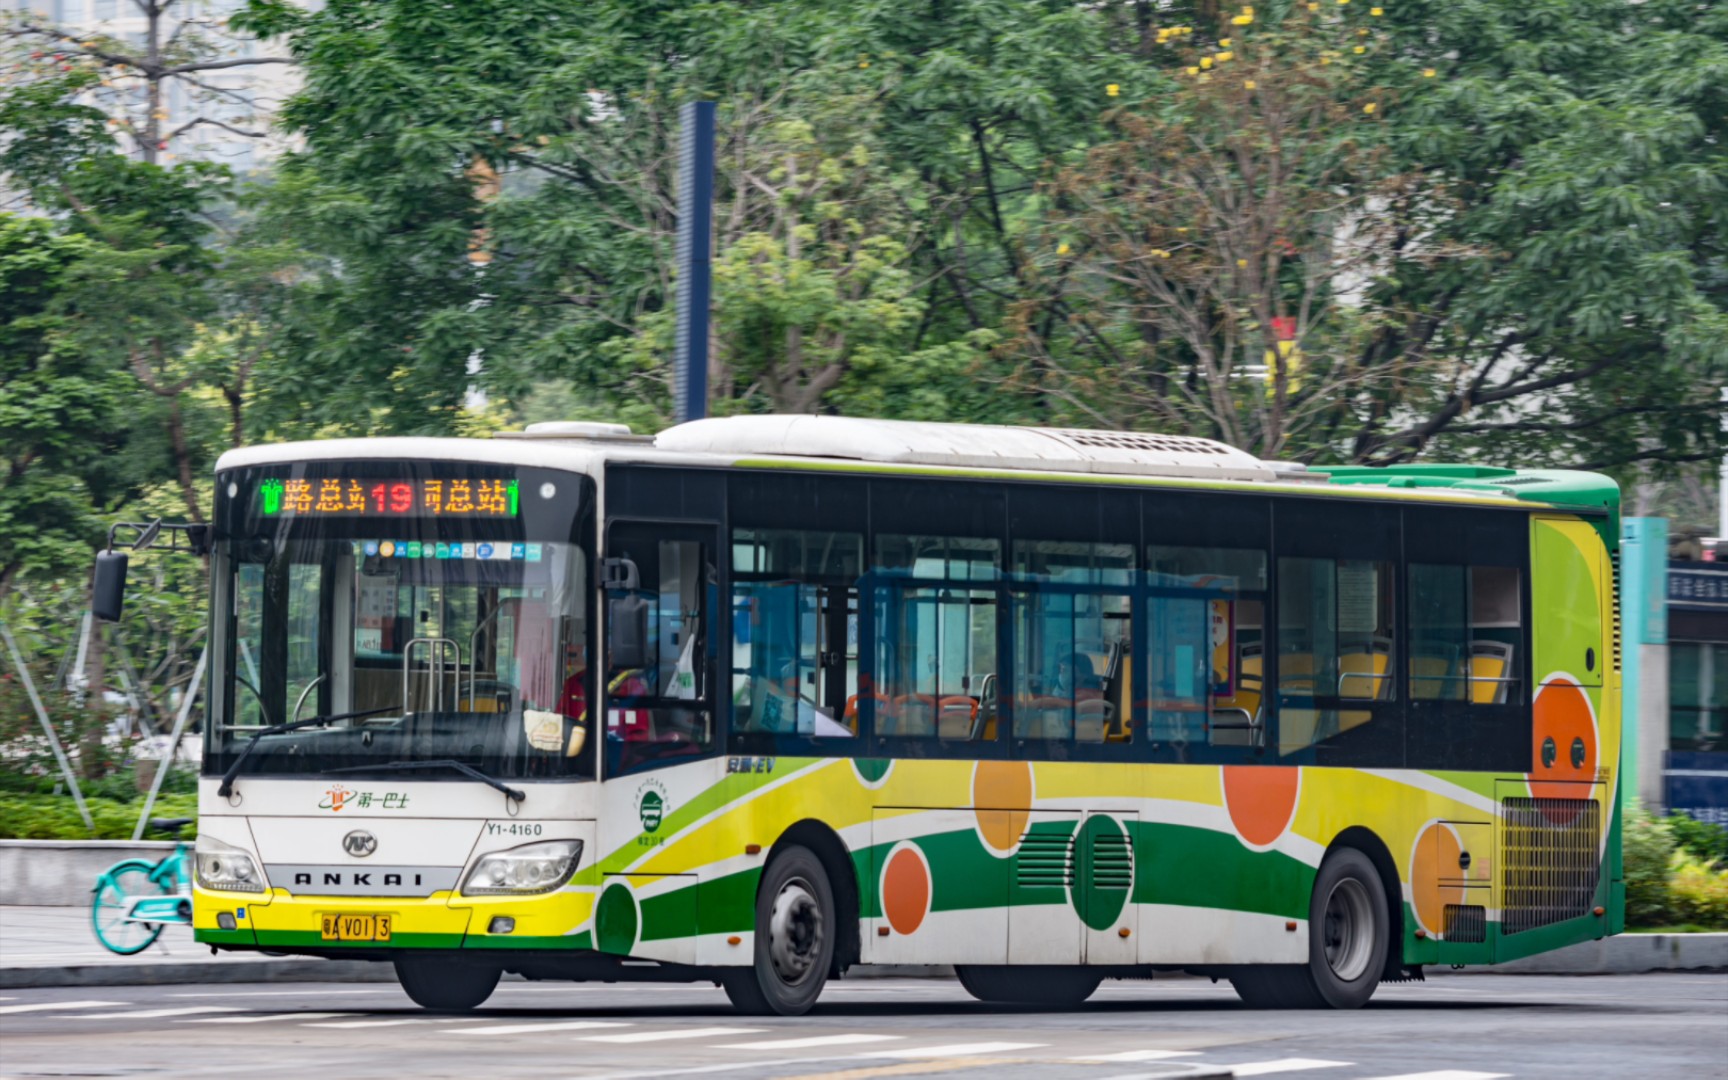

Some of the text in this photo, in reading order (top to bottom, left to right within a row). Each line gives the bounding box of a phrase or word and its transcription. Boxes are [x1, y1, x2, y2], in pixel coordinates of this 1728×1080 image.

[371, 483, 412, 512] 19
[358, 792, 410, 809] 第一巴士
[488, 822, 543, 837] Y1-4160
[295, 872, 422, 887] ANKAI
